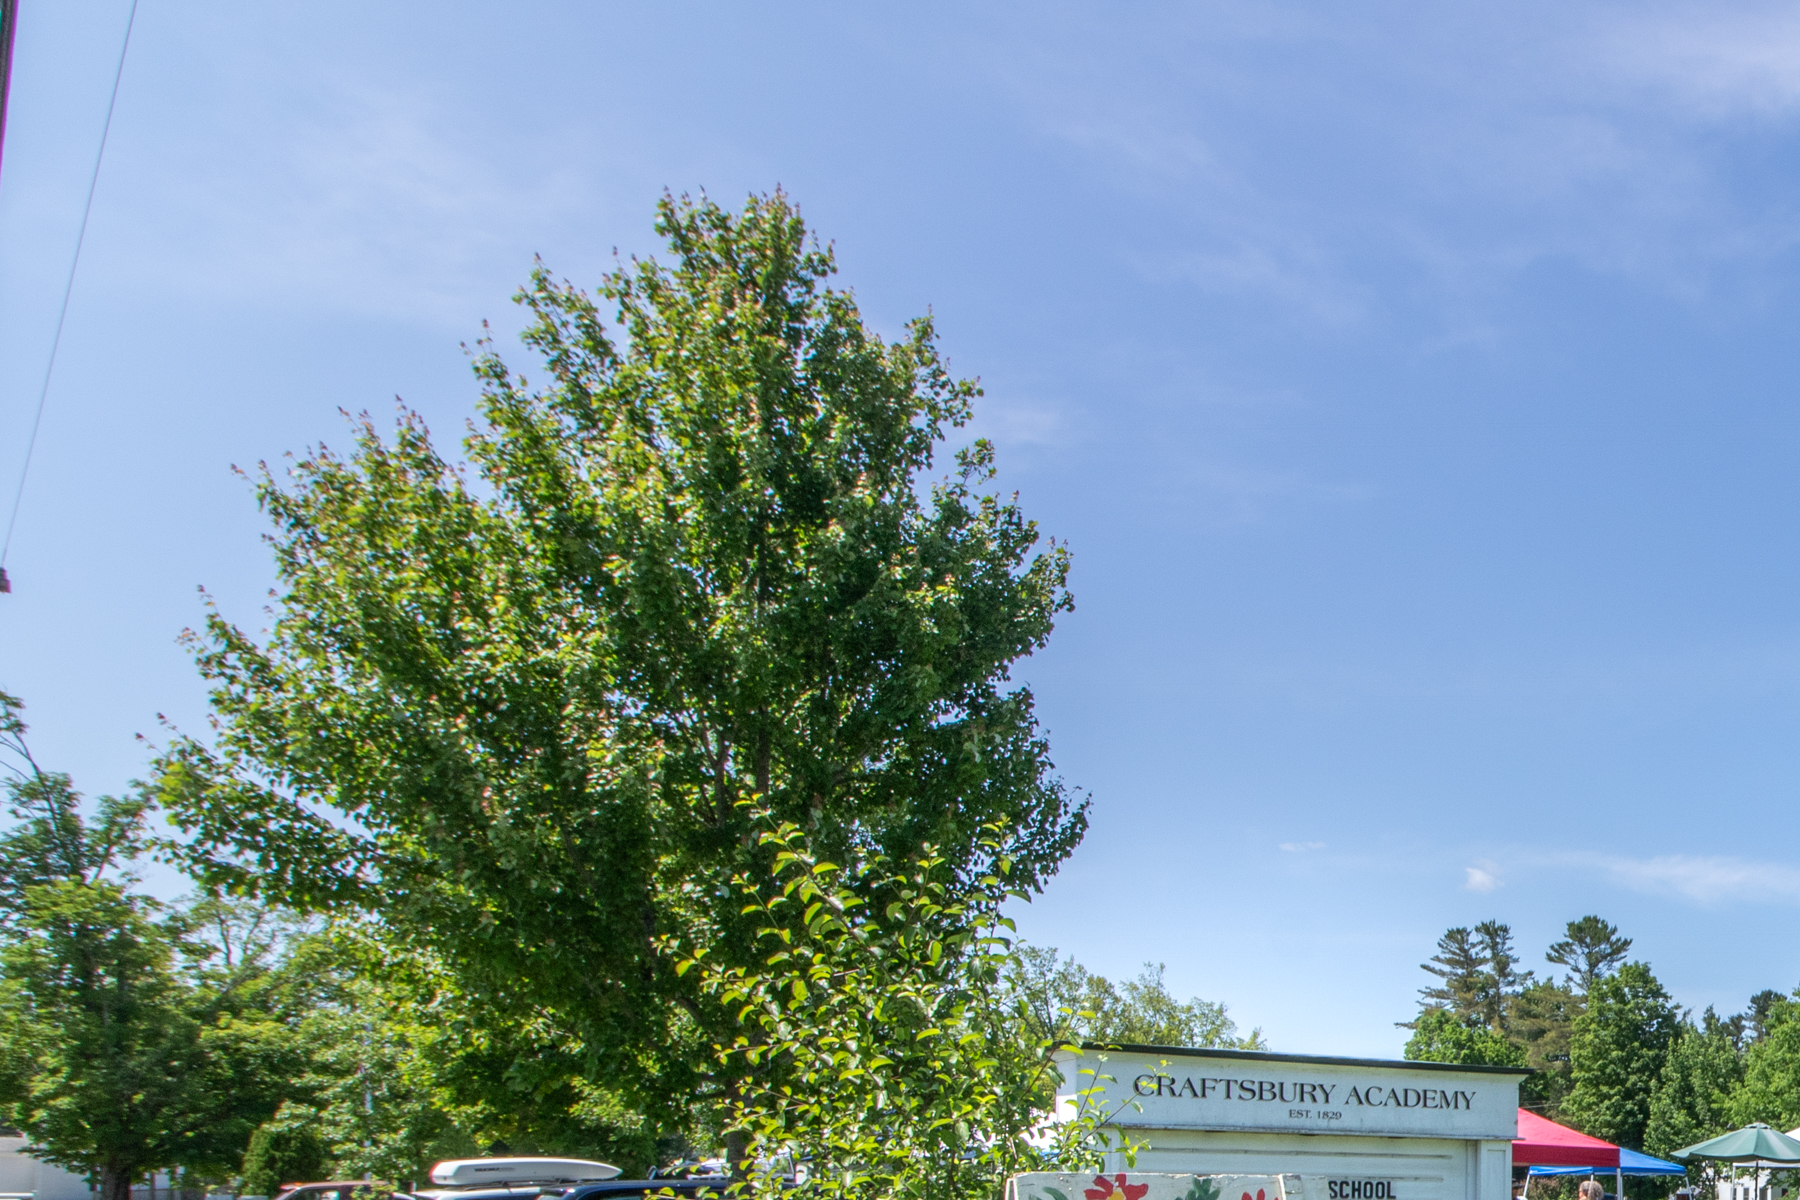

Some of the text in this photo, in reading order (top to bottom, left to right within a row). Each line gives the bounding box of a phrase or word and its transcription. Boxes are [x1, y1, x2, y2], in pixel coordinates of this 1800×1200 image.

[1132, 1074, 1476, 1110] CRAFTSBURY ACADEMY
[1289, 1109, 1342, 1120] EST. 1829
[1328, 1180, 1396, 1200] SCHOOL
